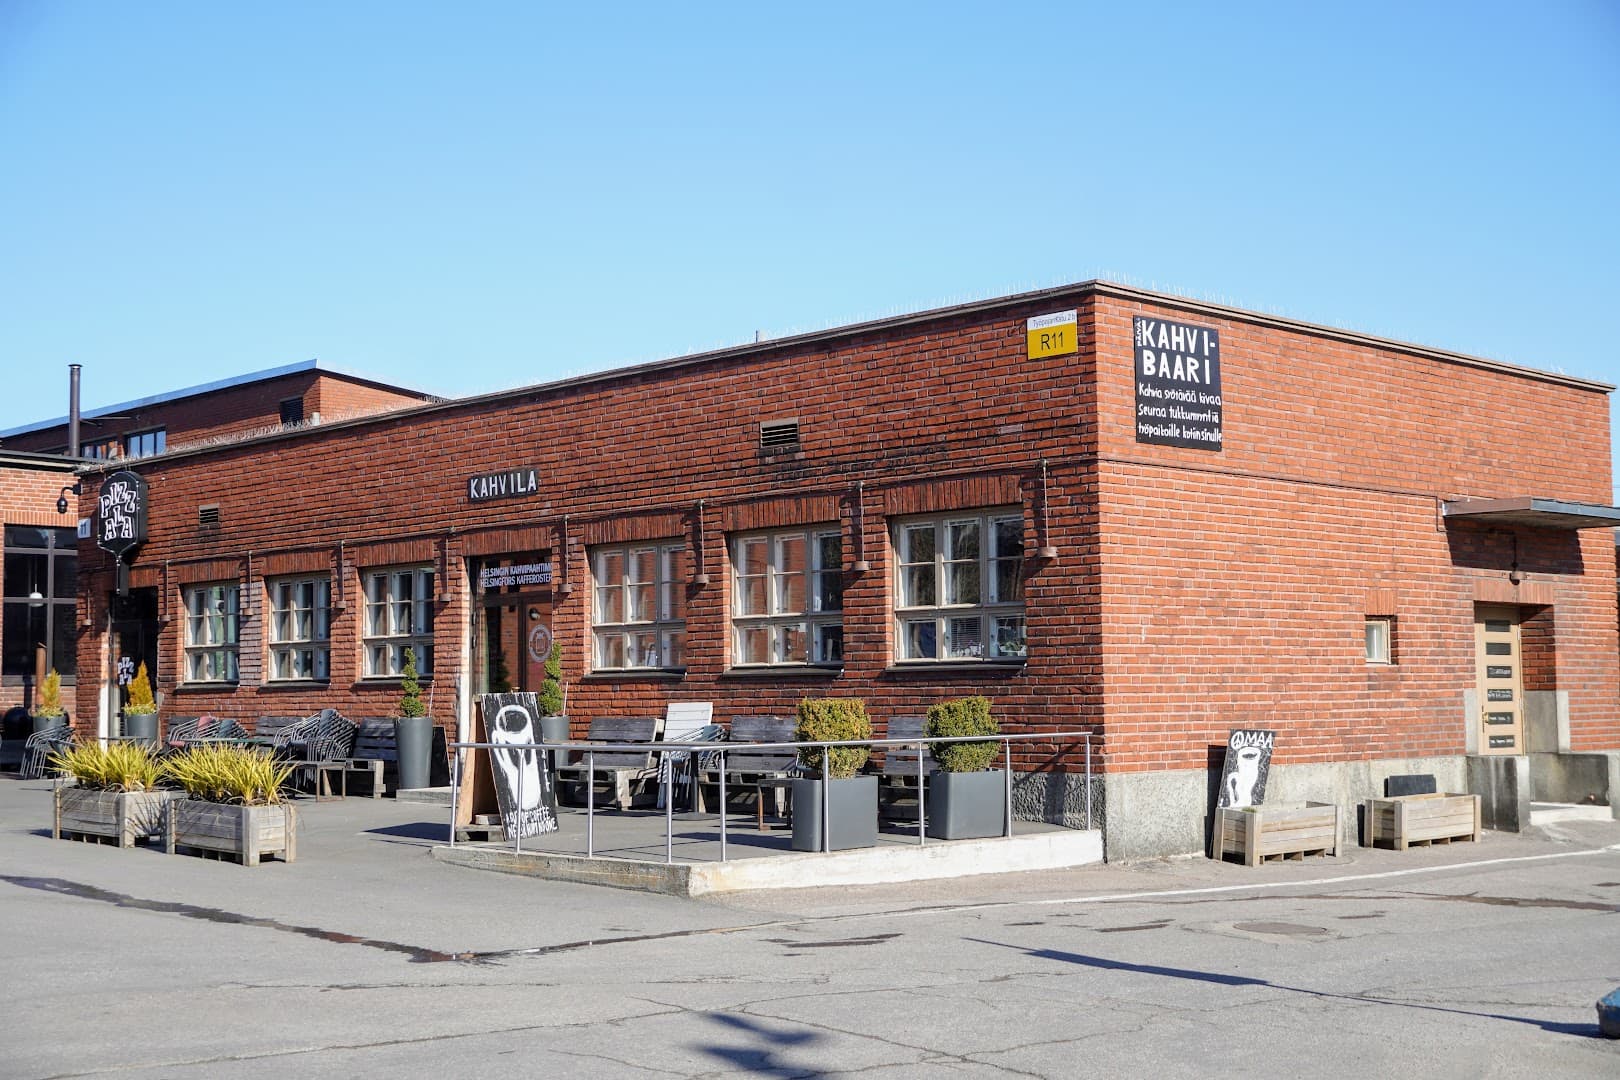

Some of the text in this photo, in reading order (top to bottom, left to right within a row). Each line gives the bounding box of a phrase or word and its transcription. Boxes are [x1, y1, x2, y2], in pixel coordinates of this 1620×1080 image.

[1041, 331, 1064, 351] R11
[1142, 319, 1216, 356] KAHVI-
[1143, 349, 1211, 385] BAARI
[1138, 382, 1162, 399] Kahvia
[1138, 403, 1166, 418] Seuraa
[470, 470, 537, 499] KAHVILA
[480, 566, 509, 578] HELSINGIN
[480, 575, 516, 588] HELSINGFORS
